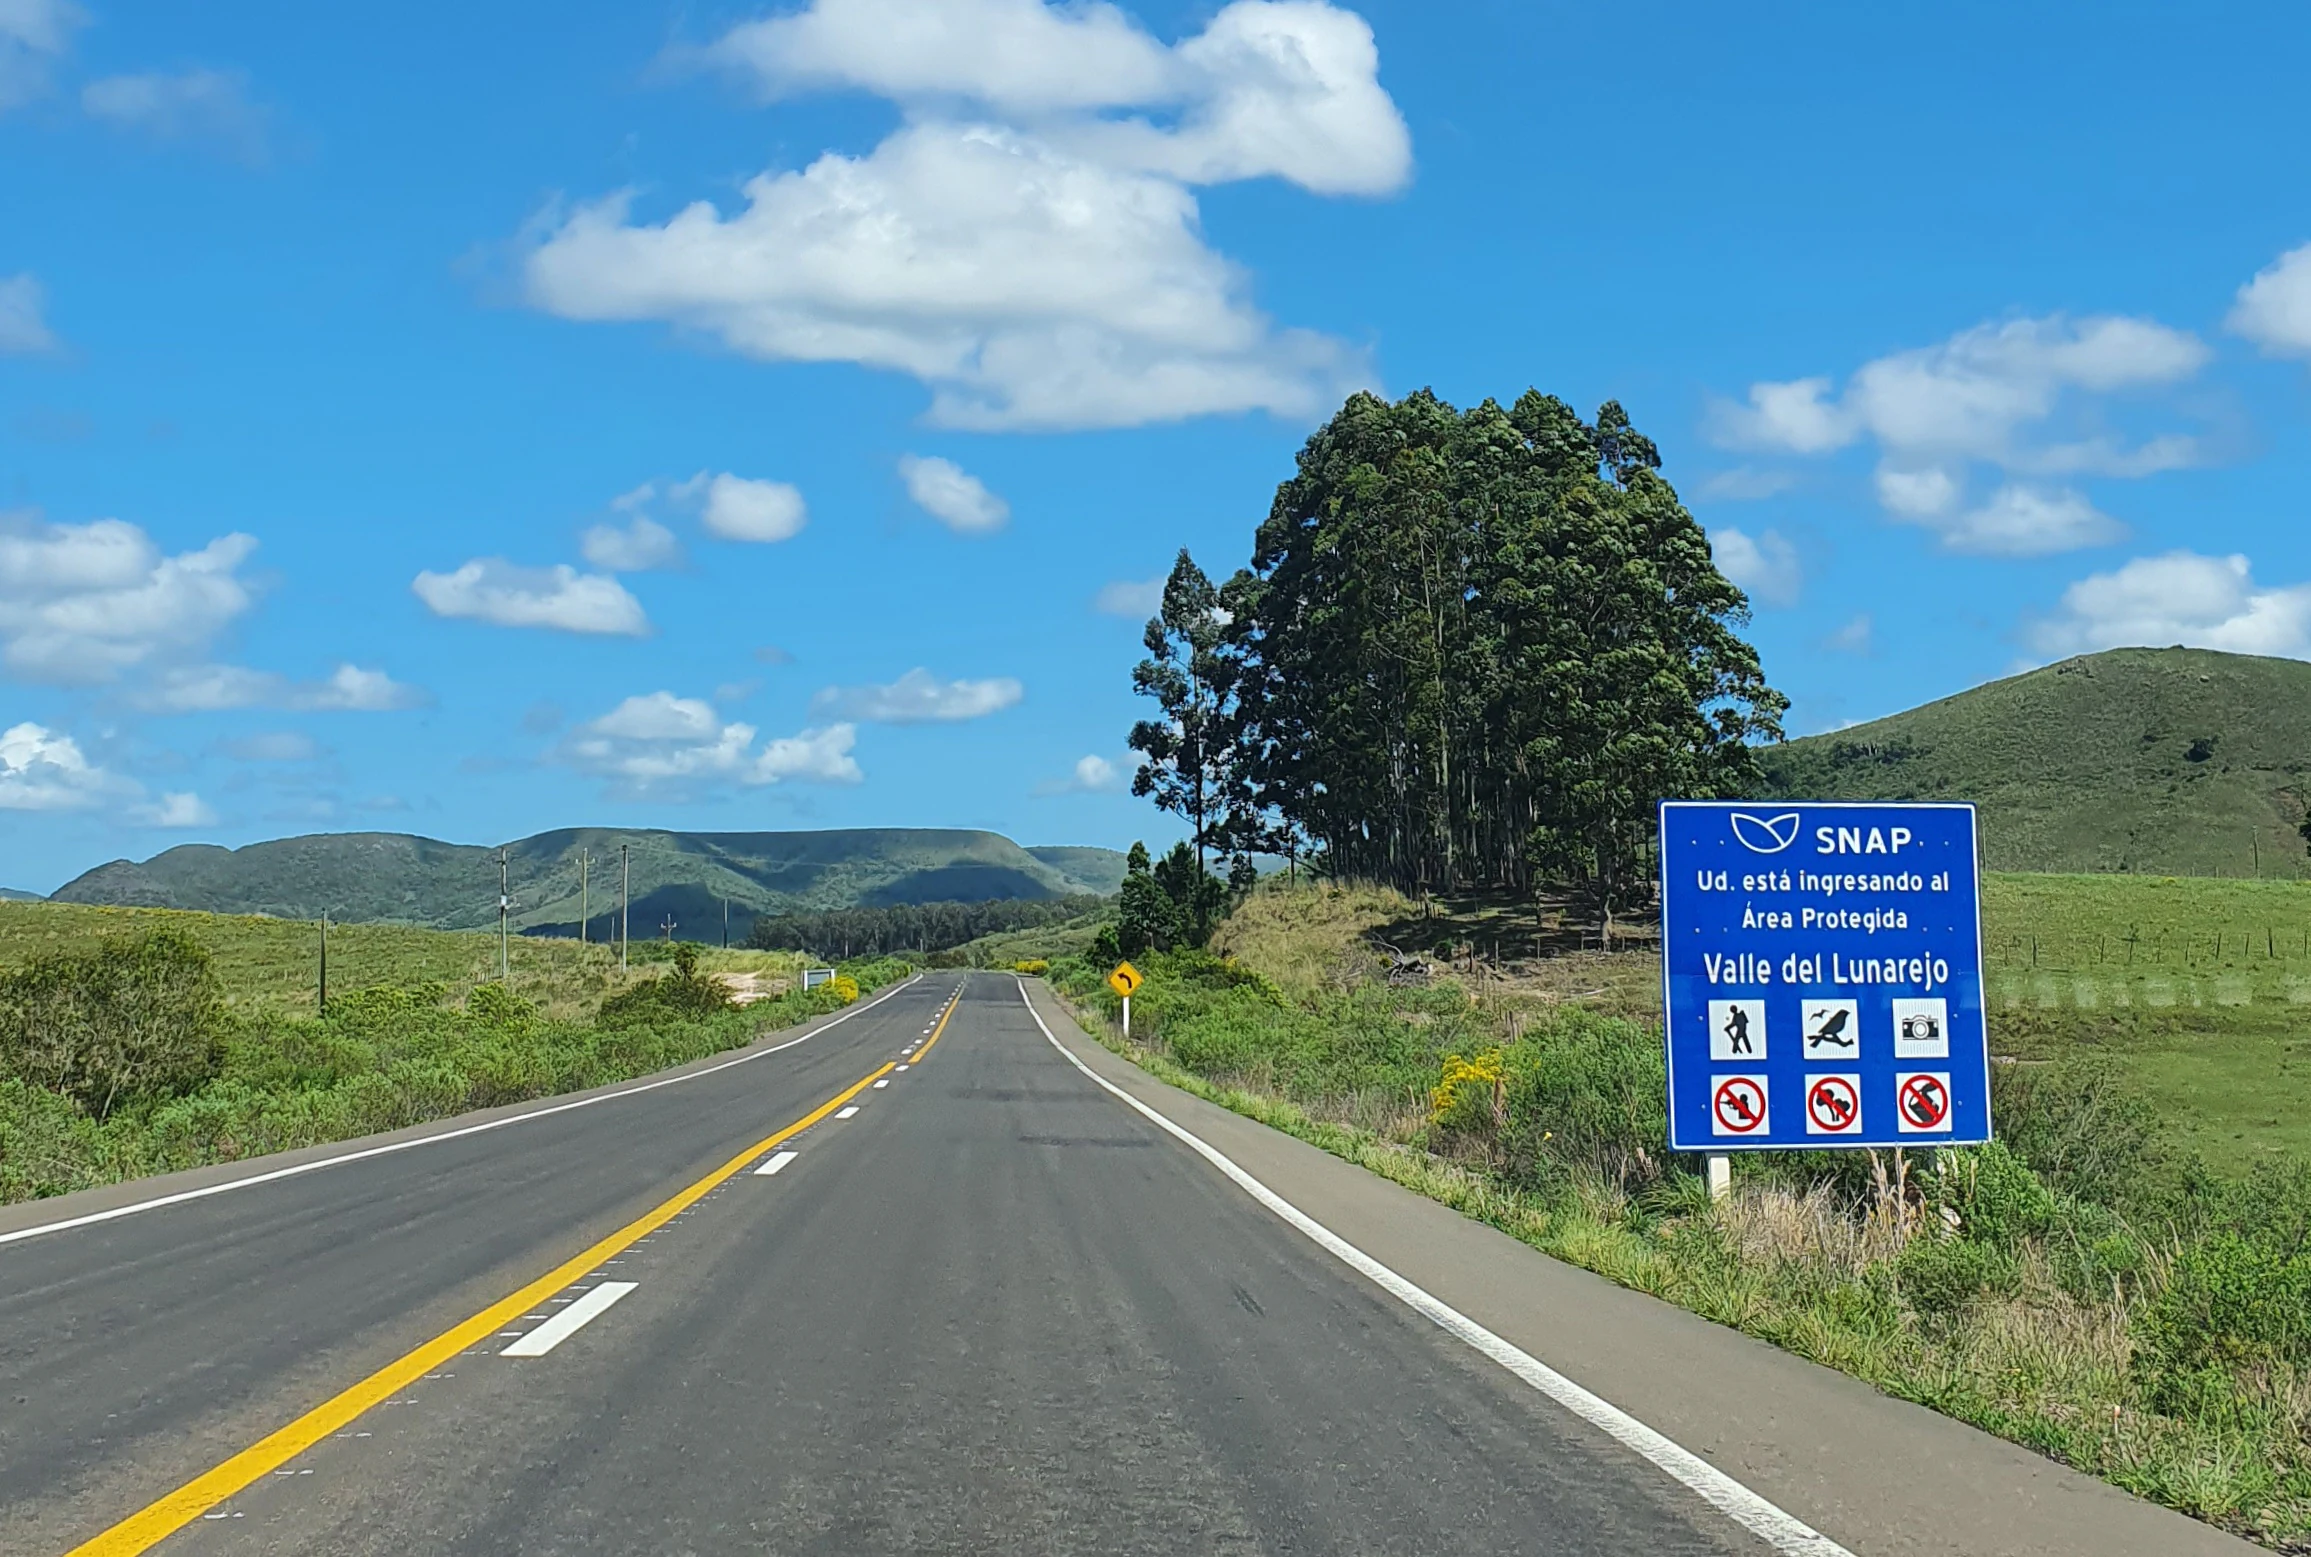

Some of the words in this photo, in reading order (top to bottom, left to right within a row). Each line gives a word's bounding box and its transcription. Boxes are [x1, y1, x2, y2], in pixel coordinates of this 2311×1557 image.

[1817, 827, 1911, 853] SNAP
[1698, 871, 1734, 890] Ud.
[1743, 869, 1790, 891] está
[1800, 870, 1922, 896] ingresando
[1931, 872, 1948, 891] al
[1743, 902, 1792, 928] Área
[1803, 908, 1907, 934] Protegida
[1704, 953, 1771, 983] Valle
[1782, 953, 1821, 983] del
[1834, 952, 1948, 991] Lunarejo
